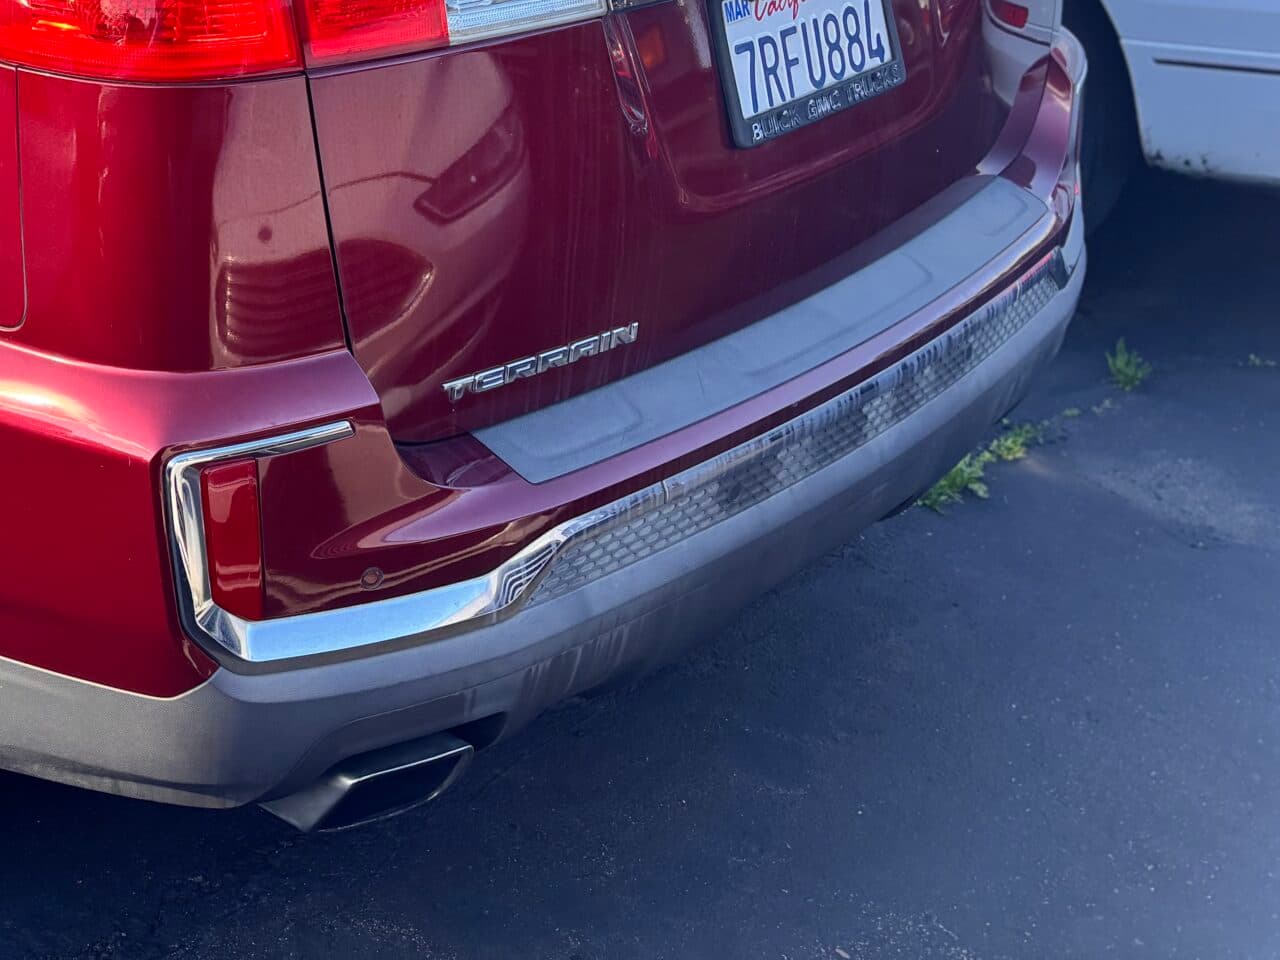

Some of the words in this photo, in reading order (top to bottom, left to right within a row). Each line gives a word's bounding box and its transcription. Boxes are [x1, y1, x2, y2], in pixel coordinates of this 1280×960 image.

[724, 0, 751, 24] MAR
[752, 103, 802, 143] BUICK
[807, 90, 842, 121] GMC
[442, 321, 640, 402] TERRAIN
